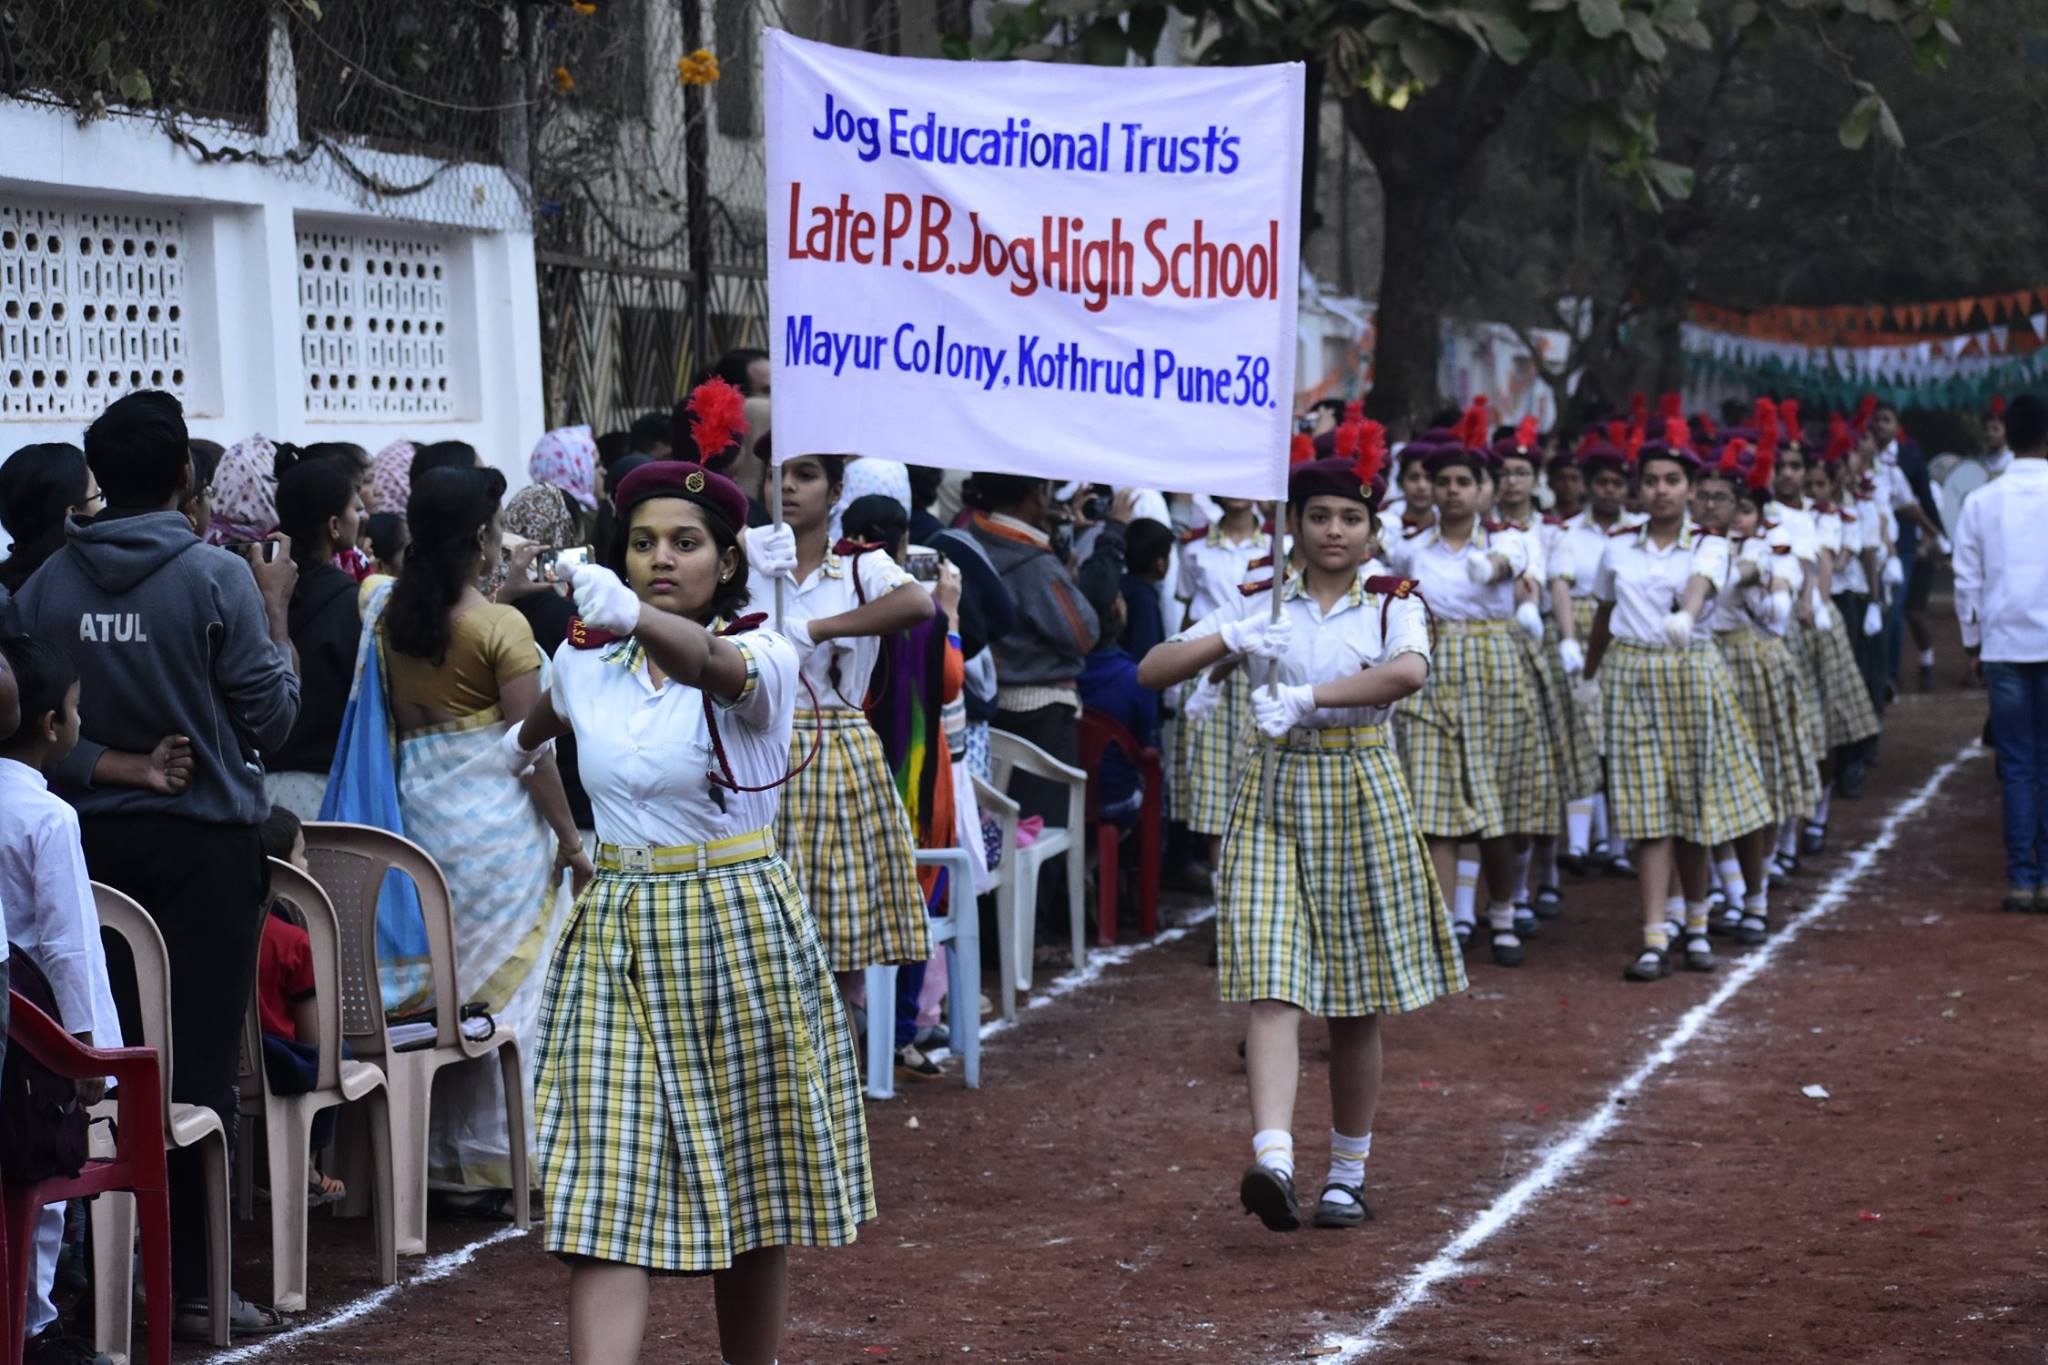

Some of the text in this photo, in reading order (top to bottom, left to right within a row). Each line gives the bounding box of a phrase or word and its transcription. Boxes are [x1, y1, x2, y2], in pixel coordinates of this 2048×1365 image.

[812, 92, 1241, 175] Jog Educational Trust's
[787, 181, 877, 265] Late
[1041, 215, 1135, 314] High
[1141, 217, 1279, 301] School
[784, 314, 889, 378] Mayur
[1017, 334, 1146, 398] Kothrud
[79, 612, 148, 642] ATUL
